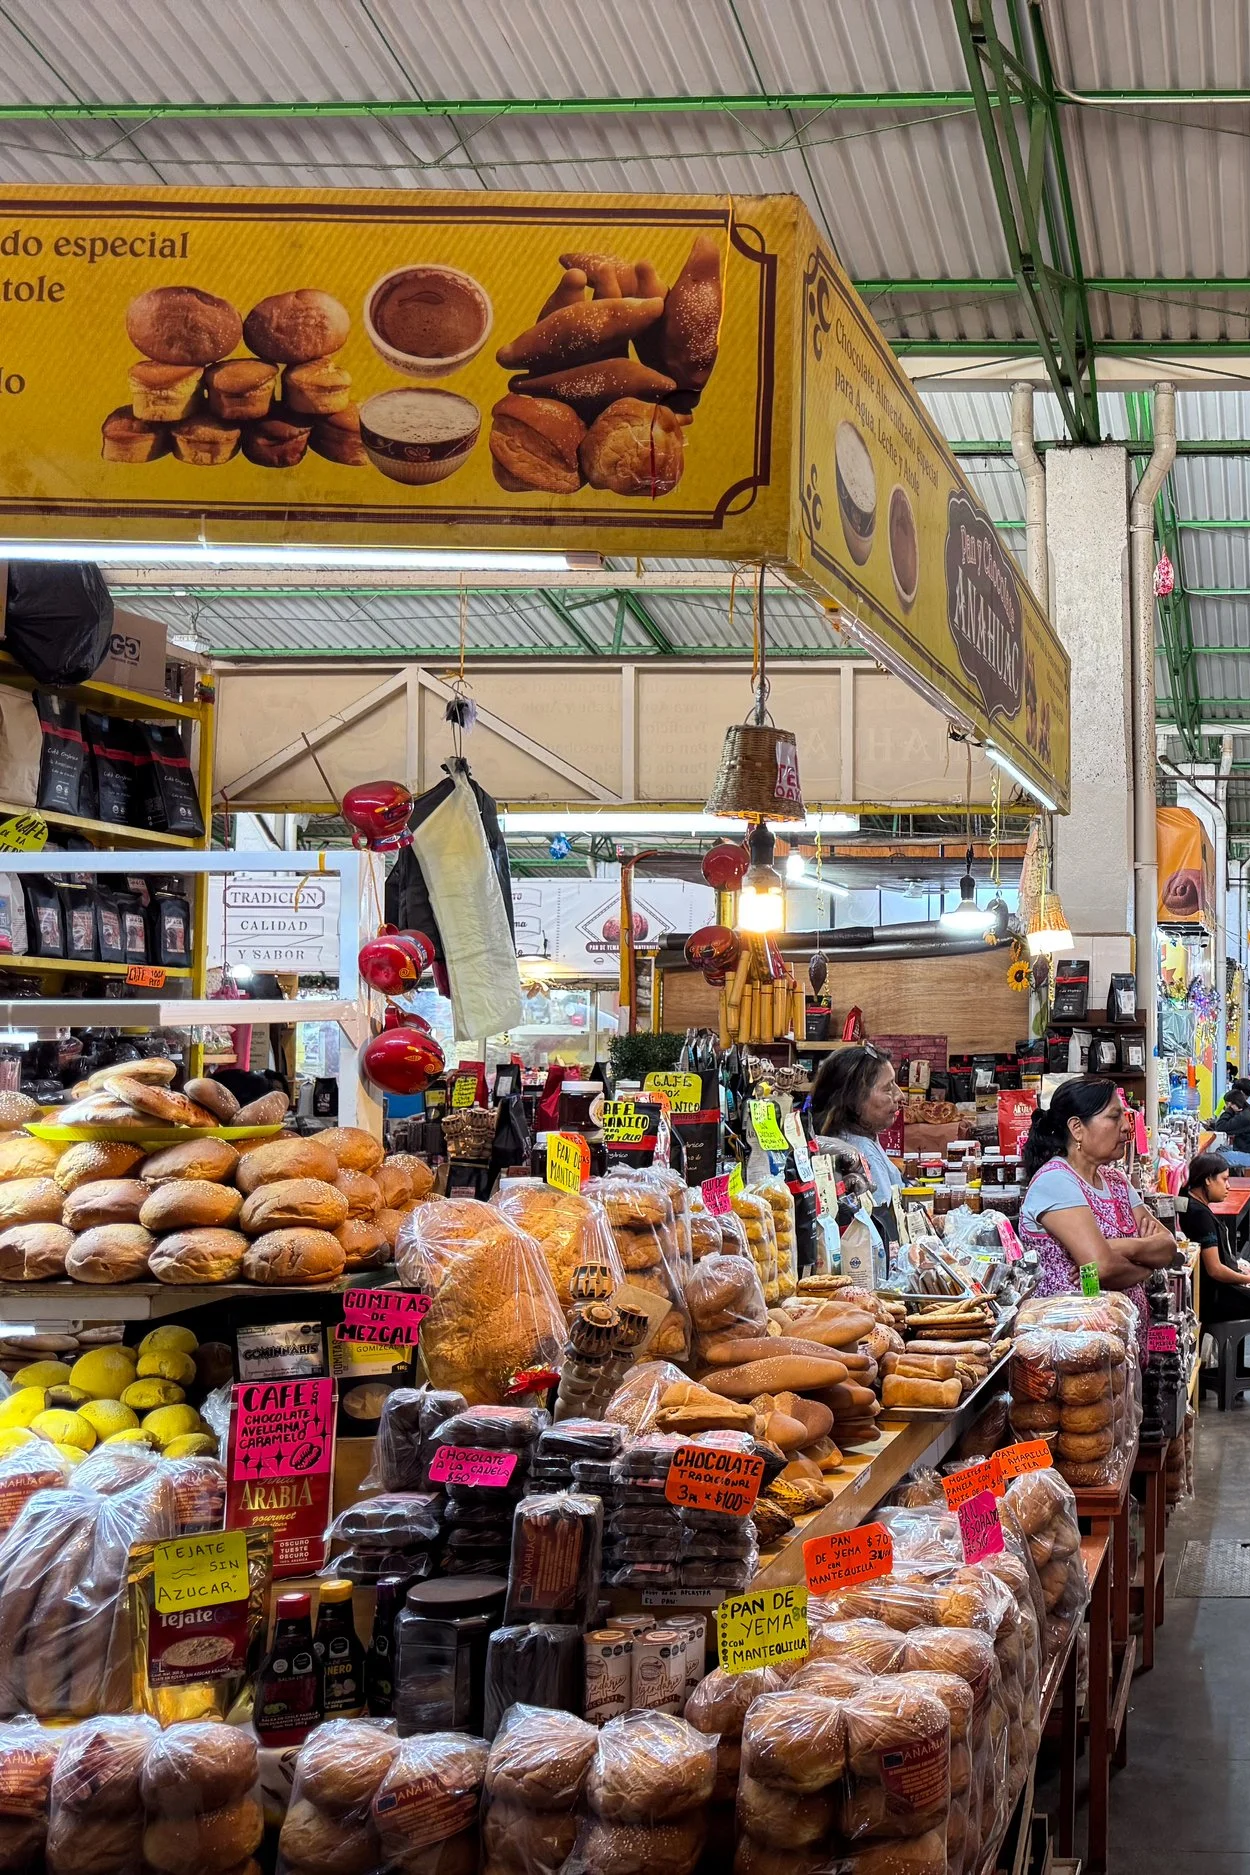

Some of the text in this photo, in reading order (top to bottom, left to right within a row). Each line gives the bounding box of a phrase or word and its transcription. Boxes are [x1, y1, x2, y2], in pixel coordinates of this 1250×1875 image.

[54, 232, 190, 264] especial
[2, 275, 65, 302] tole
[836, 318, 939, 490] Chocolate Almendrado especial
[835, 366, 854, 404] para
[878, 418, 898, 466] Leche
[903, 456, 920, 497] Atole
[960, 525, 1015, 632] Pan y Chocolate
[954, 565, 1020, 698] ANAHUAC
[230, 889, 317, 904] TRADICIÓN
[240, 920, 308, 931] CALIDAD
[238, 949, 304, 960] Y SABOR
[603, 1102, 633, 1115] AFE
[557, 1141, 569, 1164] PAN
[345, 1291, 430, 1313] GOMITAS
[370, 1312, 386, 1321] DE
[337, 1323, 416, 1345] MEZCAL
[243, 1383, 308, 1412] CAFE
[245, 1409, 310, 1426] CHOCOLATE
[241, 1422, 298, 1438] AVELLANA
[239, 1432, 307, 1450] CARAMELO
[438, 1448, 506, 1465] CHOCOLATE
[672, 1448, 762, 1477] CHOCOLATE
[1008, 1447, 1049, 1466] AMARILLO
[436, 1461, 509, 1477] A LA CANELA
[446, 1472, 470, 1482] $50
[948, 1466, 981, 1485] MOLLETES
[677, 1469, 750, 1489] TRADICIONAL
[946, 1473, 990, 1497] PANELA CON
[239, 1477, 313, 1511] ARABIA
[948, 1492, 970, 1507] ANIS
[252, 1511, 297, 1526] gourmet
[279, 1539, 310, 1548] OSCURO
[280, 1546, 309, 1554] TUESTE
[830, 1536, 851, 1549] PAN
[279, 1552, 310, 1560] OSCURO
[523, 1535, 537, 1587] ANAHUAC
[815, 1546, 861, 1565] DE YEMA
[210, 1560, 239, 1572] SIN
[827, 1561, 841, 1570] CON
[731, 1590, 794, 1619] PAN DE
[792, 1606, 808, 1622] 80
[160, 1609, 213, 1629] Tejate
[741, 1613, 794, 1639] YEMA
[729, 1639, 744, 1648] CON
[733, 1638, 808, 1665] MANTEQUILLA
